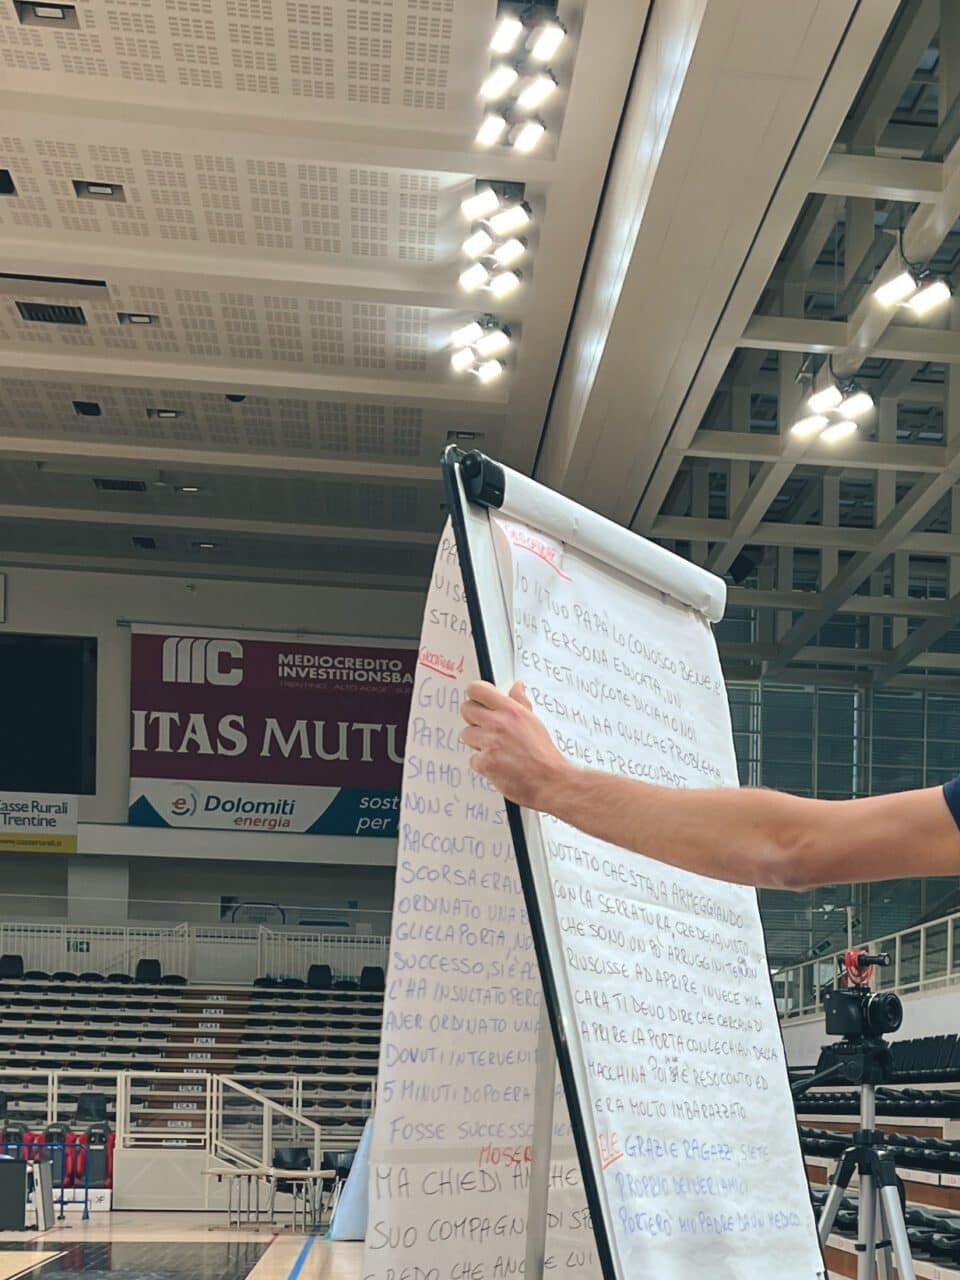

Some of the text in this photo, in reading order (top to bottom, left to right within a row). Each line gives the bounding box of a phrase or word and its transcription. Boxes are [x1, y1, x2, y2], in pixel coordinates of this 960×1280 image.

[541, 618, 608, 667] PERSONA
[628, 632, 677, 674] CONOSCO
[277, 653, 403, 671] MEDIOCREDITO
[277, 666, 414, 684] INVESTITIONSBA
[131, 709, 249, 757] ITAS
[593, 714, 613, 737] HA
[0, 800, 68, 815] asse Rurali
[203, 793, 296, 816] Dolomiti
[0, 812, 57, 828] Trentine
[234, 815, 291, 830] energia
[400, 861, 477, 886] SCORSA
[602, 859, 628, 883] CHE
[398, 894, 481, 919] ORDINATO
[553, 879, 577, 901] CON
[579, 884, 593, 910] LA
[560, 916, 585, 937] CHE
[589, 923, 625, 948] SONO
[566, 946, 630, 978] RIUSCISSE
[635, 962, 654, 983] AD
[433, 982, 505, 1004] INSULTATO
[574, 989, 610, 1015] CARA
[611, 992, 628, 1014] TI
[631, 994, 665, 1021] DEVO
[668, 1006, 695, 1025] DIRE
[384, 1011, 423, 1032] AVER
[429, 1015, 507, 1035] ORDINATO
[632, 1027, 646, 1046] LA
[647, 1028, 685, 1053] PORTA
[384, 1043, 444, 1067] DOVUTI
[587, 1058, 647, 1083] MACCHINA
[383, 1080, 396, 1103] 5
[401, 1080, 457, 1102] MINUTI
[594, 1096, 625, 1113] ERA
[629, 1098, 667, 1118] MOLTO
[389, 1116, 446, 1144] FOSSE
[624, 1135, 679, 1160] GRAZIE
[375, 1166, 501, 1200] MA CHIEDI
[369, 1220, 417, 1249] SUO
[451, 1261, 483, 1280] CHE
[566, 1250, 593, 1268] LUI
